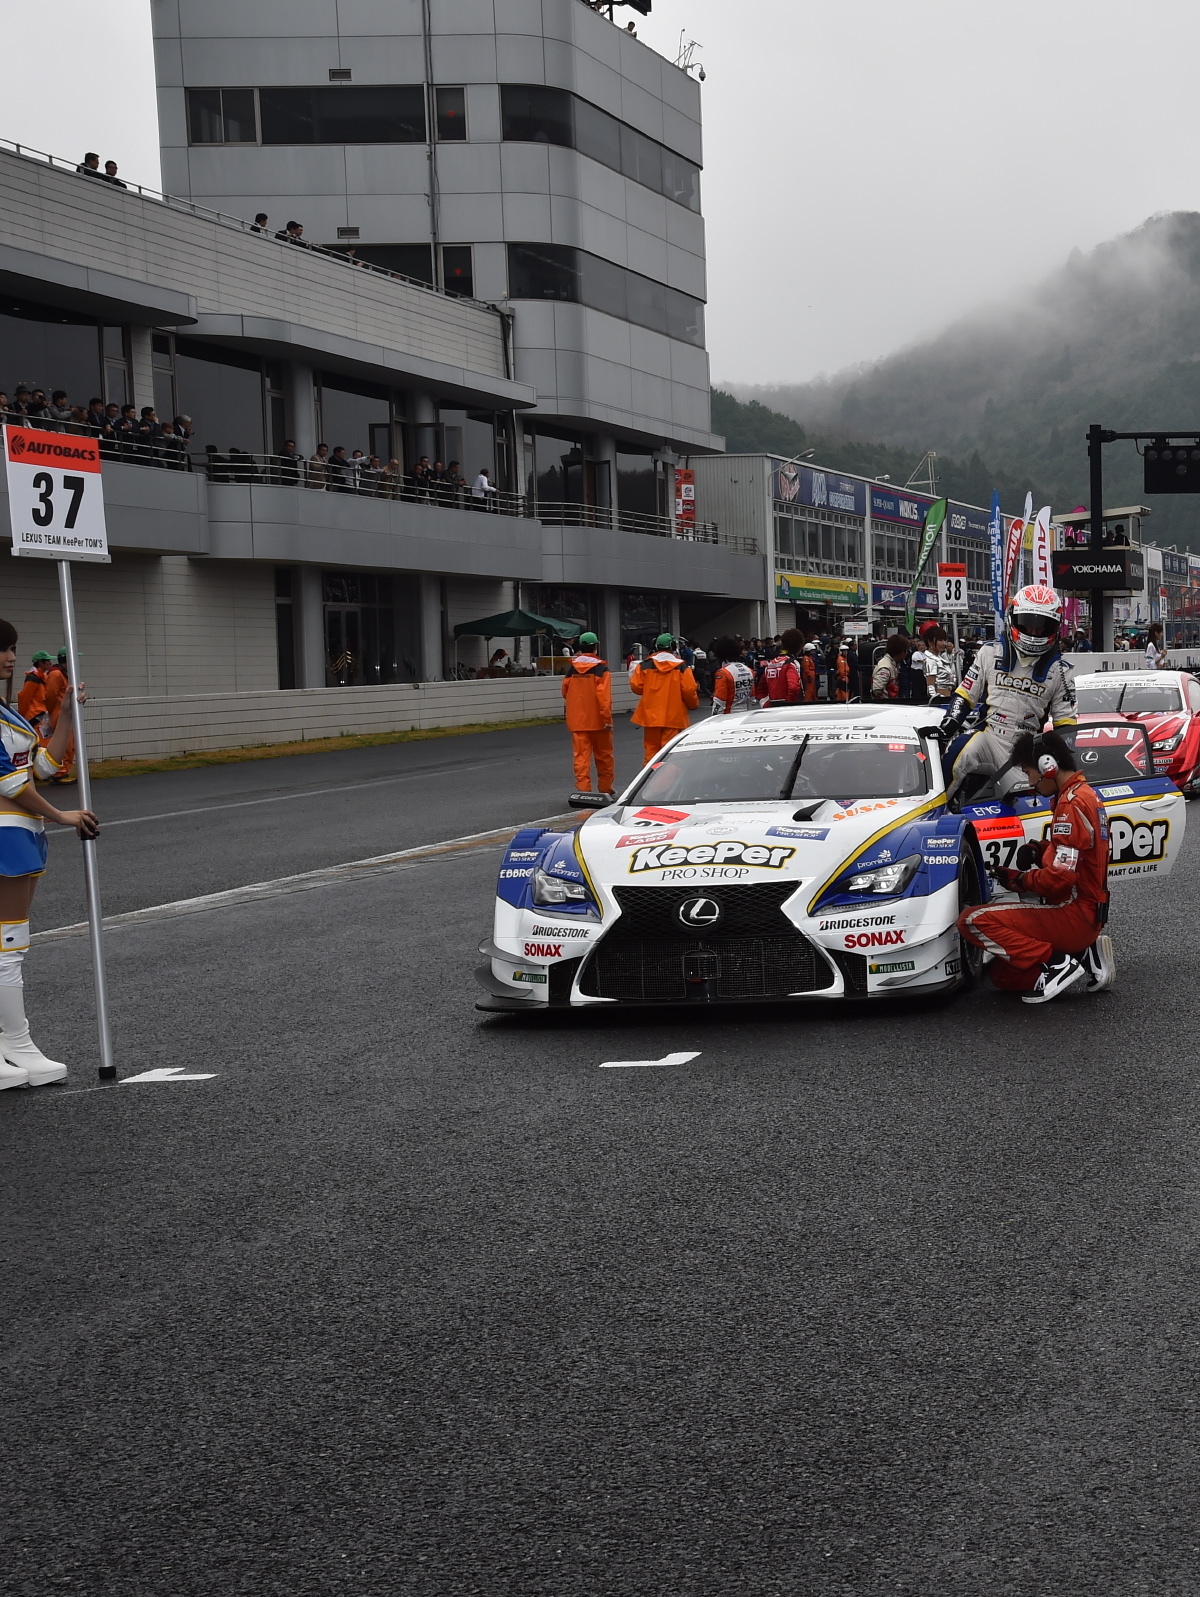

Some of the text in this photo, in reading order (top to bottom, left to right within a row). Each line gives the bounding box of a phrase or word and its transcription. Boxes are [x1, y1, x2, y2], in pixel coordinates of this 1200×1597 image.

[27, 442, 95, 461] AUTOBACS
[32, 472, 85, 529] 37
[22, 532, 103, 548] LEXUS TEAM KeePer TOM'S
[1072, 564, 1122, 574] YOKOHAMA
[945, 579, 961, 601] 38
[996, 673, 1045, 696] KeePer
[720, 732, 868, 744] ニッポンを元気に!
[1075, 727, 1141, 741] ENT
[833, 799, 898, 822] SUSAS
[972, 805, 1001, 816] ENG
[776, 826, 823, 835] KeePer
[982, 824, 1021, 833] AUTOBACS
[624, 837, 668, 846] LABO
[1108, 820, 1168, 861] Per
[633, 842, 795, 872] KeePer
[985, 840, 1018, 870] 37
[857, 857, 892, 869] promina
[550, 868, 580, 878] promina
[660, 867, 750, 881] PRO SHOP
[1108, 864, 1158, 877] MART CAR LIFE
[819, 915, 897, 931] BRIDGESTONE
[532, 925, 591, 938] BRIDGESTONE
[844, 929, 905, 949] SONAX
[524, 943, 563, 957] SONAX
[879, 962, 914, 972] MODELLISTA
